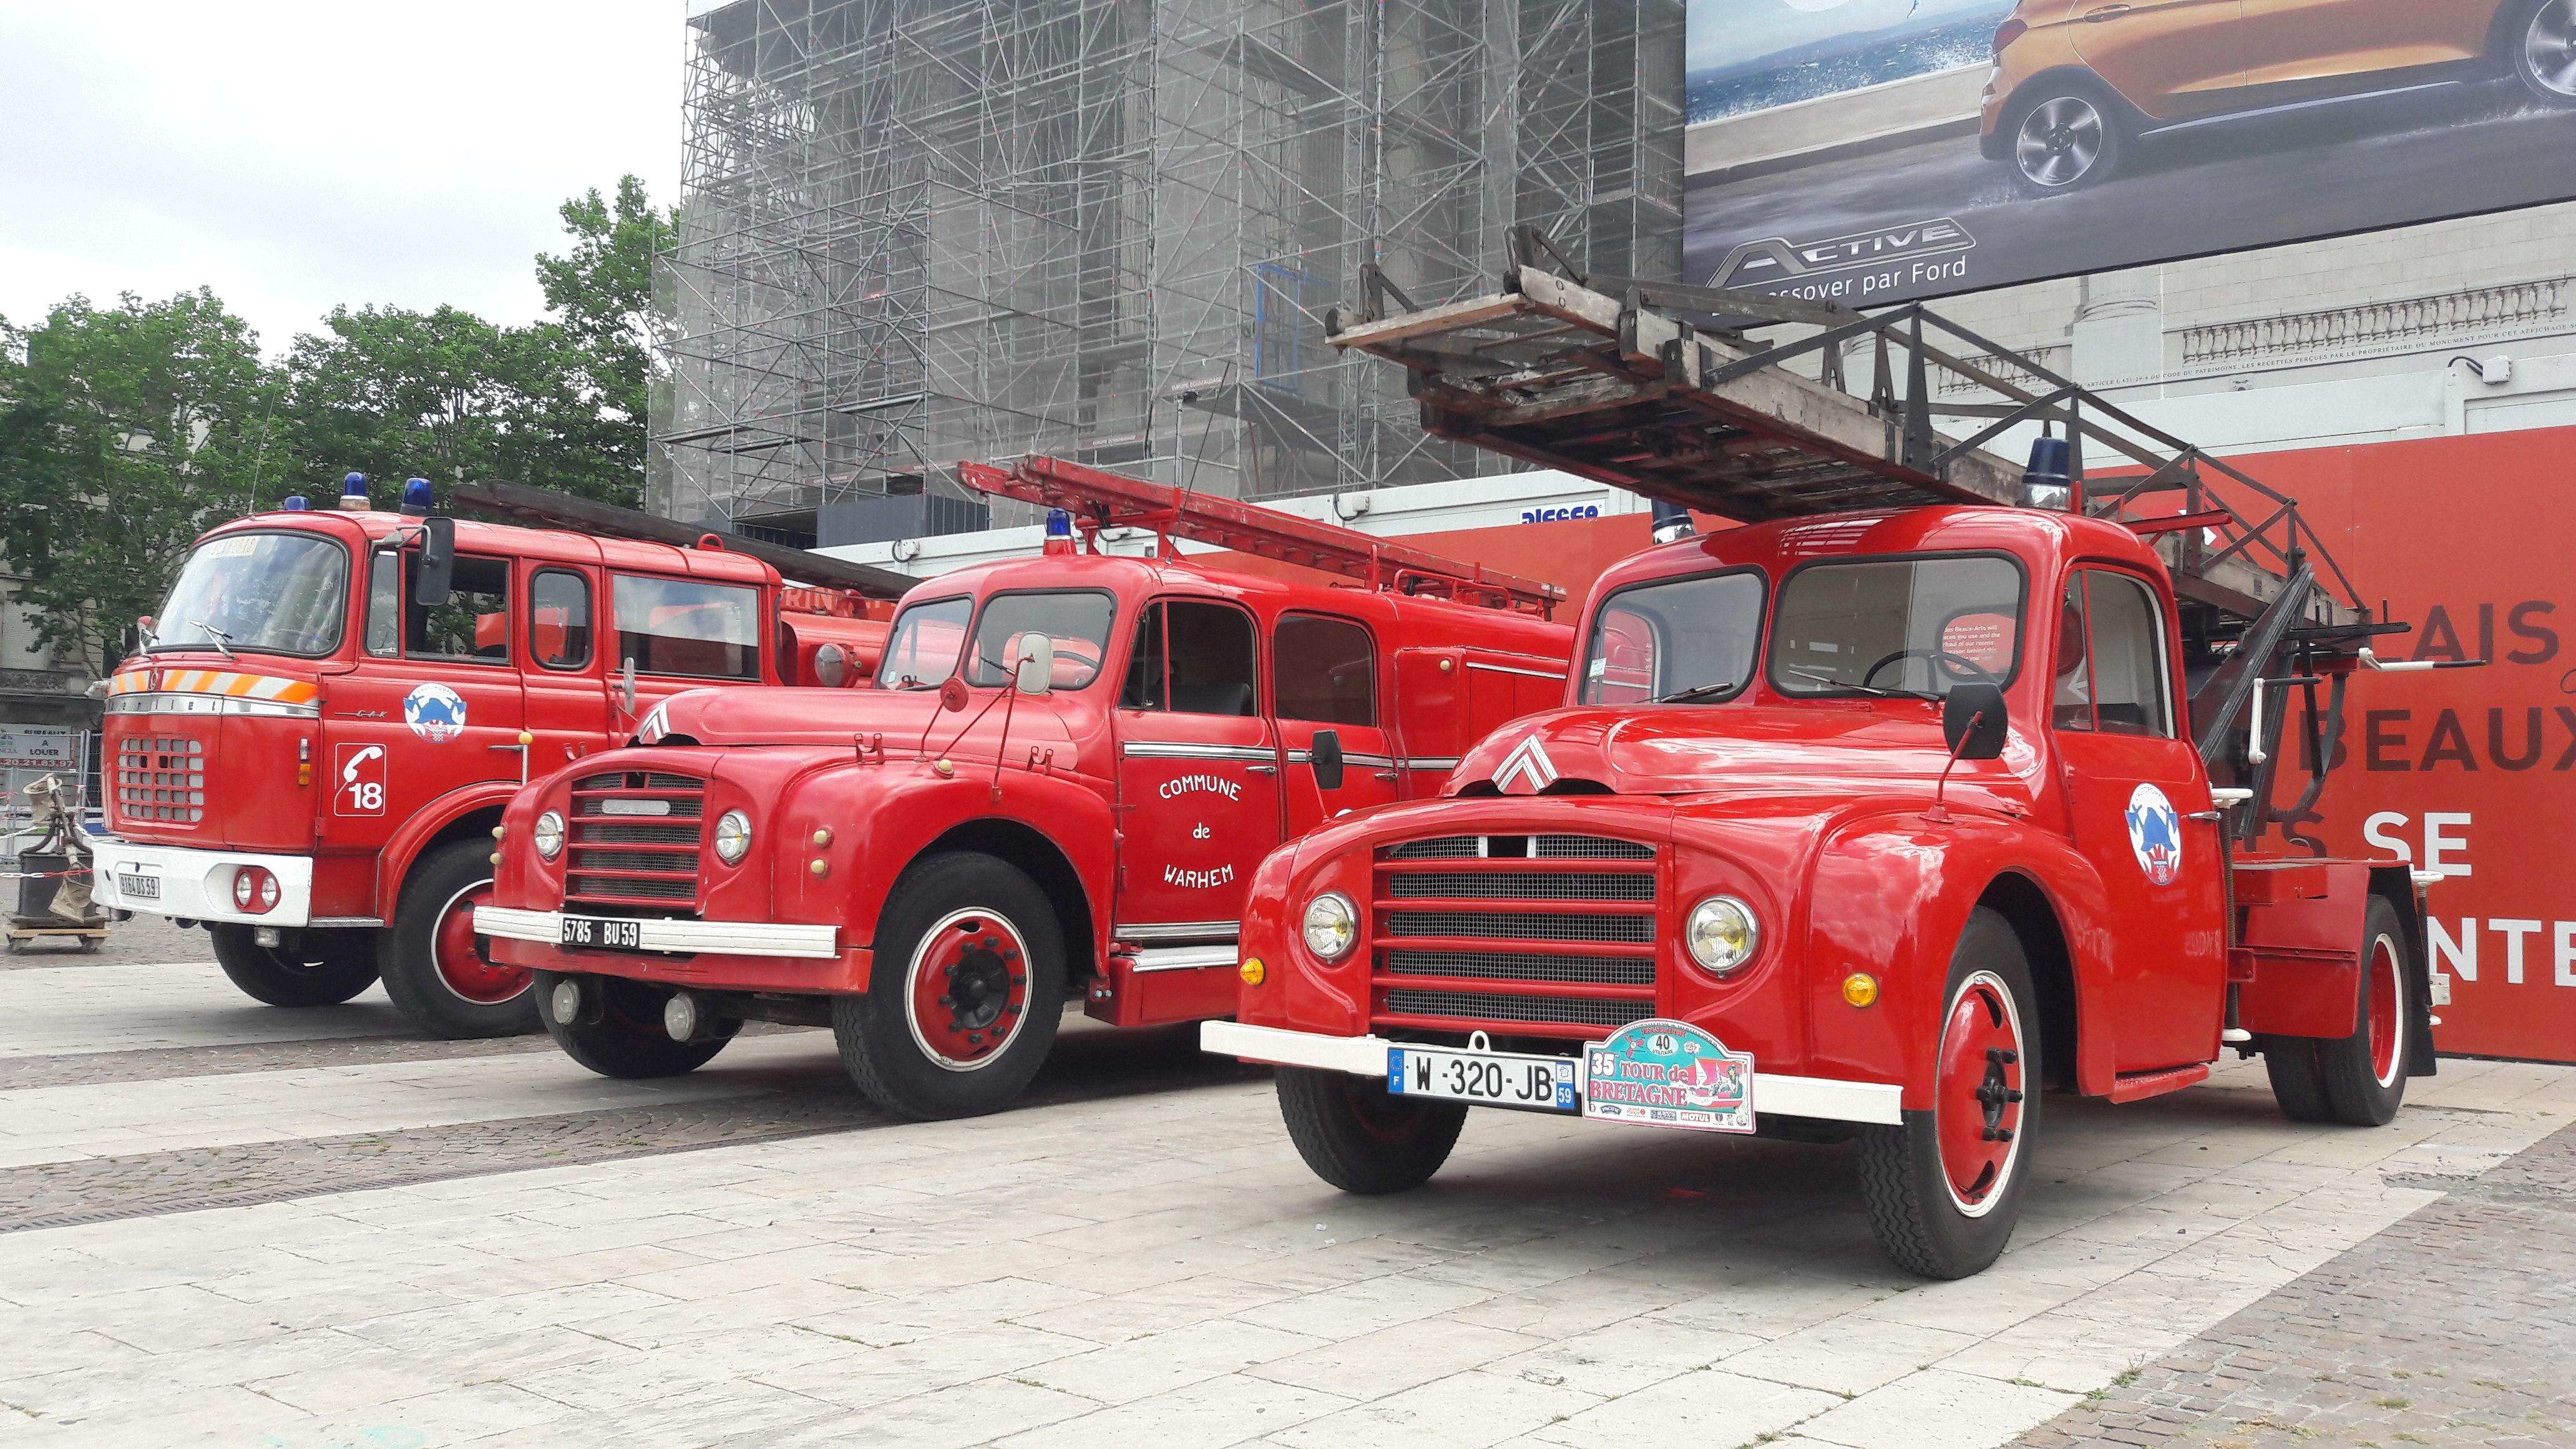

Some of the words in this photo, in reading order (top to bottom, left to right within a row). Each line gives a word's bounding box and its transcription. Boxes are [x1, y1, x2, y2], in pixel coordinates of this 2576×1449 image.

[1708, 225, 1961, 288] ACTIVE
[1863, 271, 1901, 296] par
[1911, 255, 1967, 284] Ford
[2257, 358, 2293, 368] RECETTES
[2358, 344, 2413, 356] PROPRIETAIRE
[2429, 336, 2475, 347] MONUMENT
[2521, 323, 2566, 334] AFFICHAGE
[348, 782, 383, 809] 18
[1159, 774, 1242, 802] COMMUNE
[1193, 822, 1211, 839] de
[2363, 811, 2472, 876] SE
[1164, 863, 1234, 889] WARHEM
[564, 920, 592, 943] 5785
[1656, 1035, 1670, 1050] 40
[1393, 1075, 1400, 1086] F
[1591, 1052, 1615, 1076] 35
[1620, 1061, 1666, 1081] TOUR
[1668, 1065, 1689, 1083] de
[1558, 1087, 1571, 1104] 59
[1590, 1080, 1688, 1106] BRETAGNE
[1681, 1113, 1709, 1121] MOTUL
